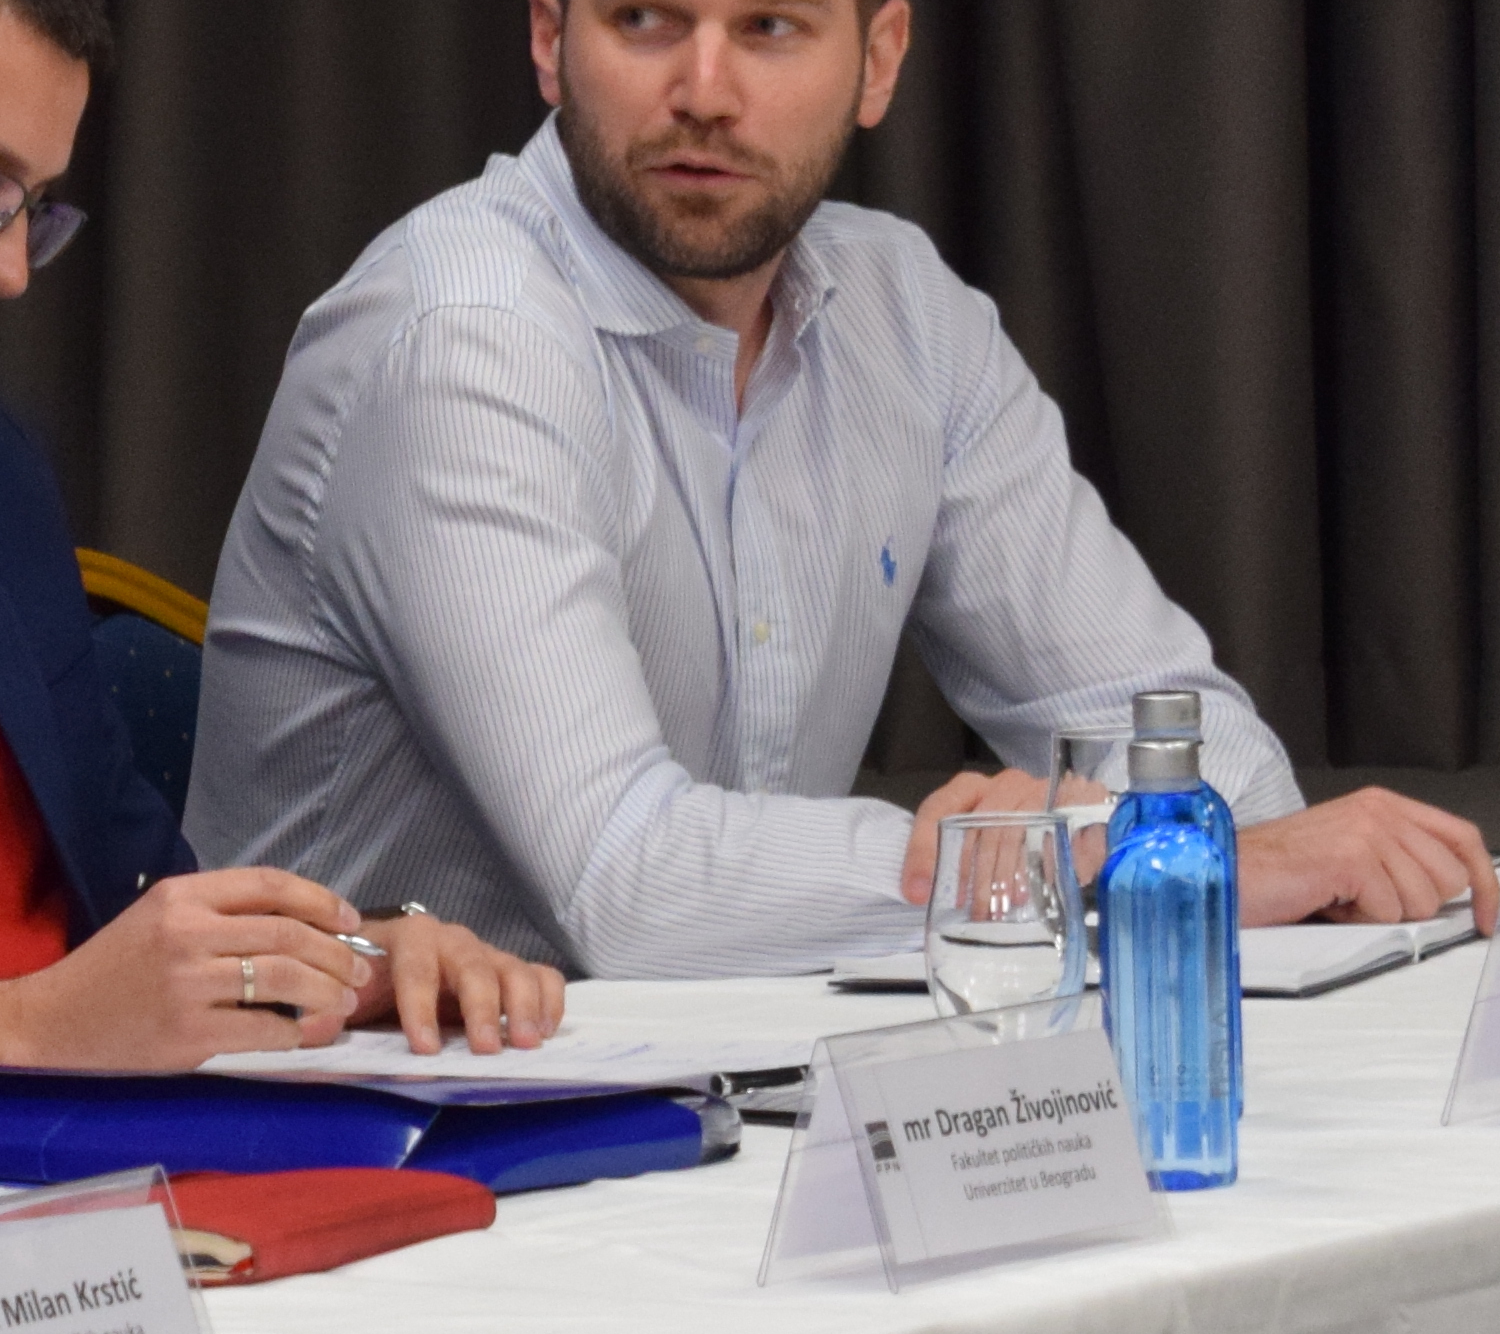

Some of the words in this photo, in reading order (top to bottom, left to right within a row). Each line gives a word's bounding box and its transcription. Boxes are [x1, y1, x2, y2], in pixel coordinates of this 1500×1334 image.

[903, 1117, 931, 1142] mr
[935, 1105, 1010, 1138] Dragan
[1009, 1079, 1118, 1125] Živojinović
[1, 1289, 72, 1327] Milan
[73, 1268, 142, 1312] Krstić
